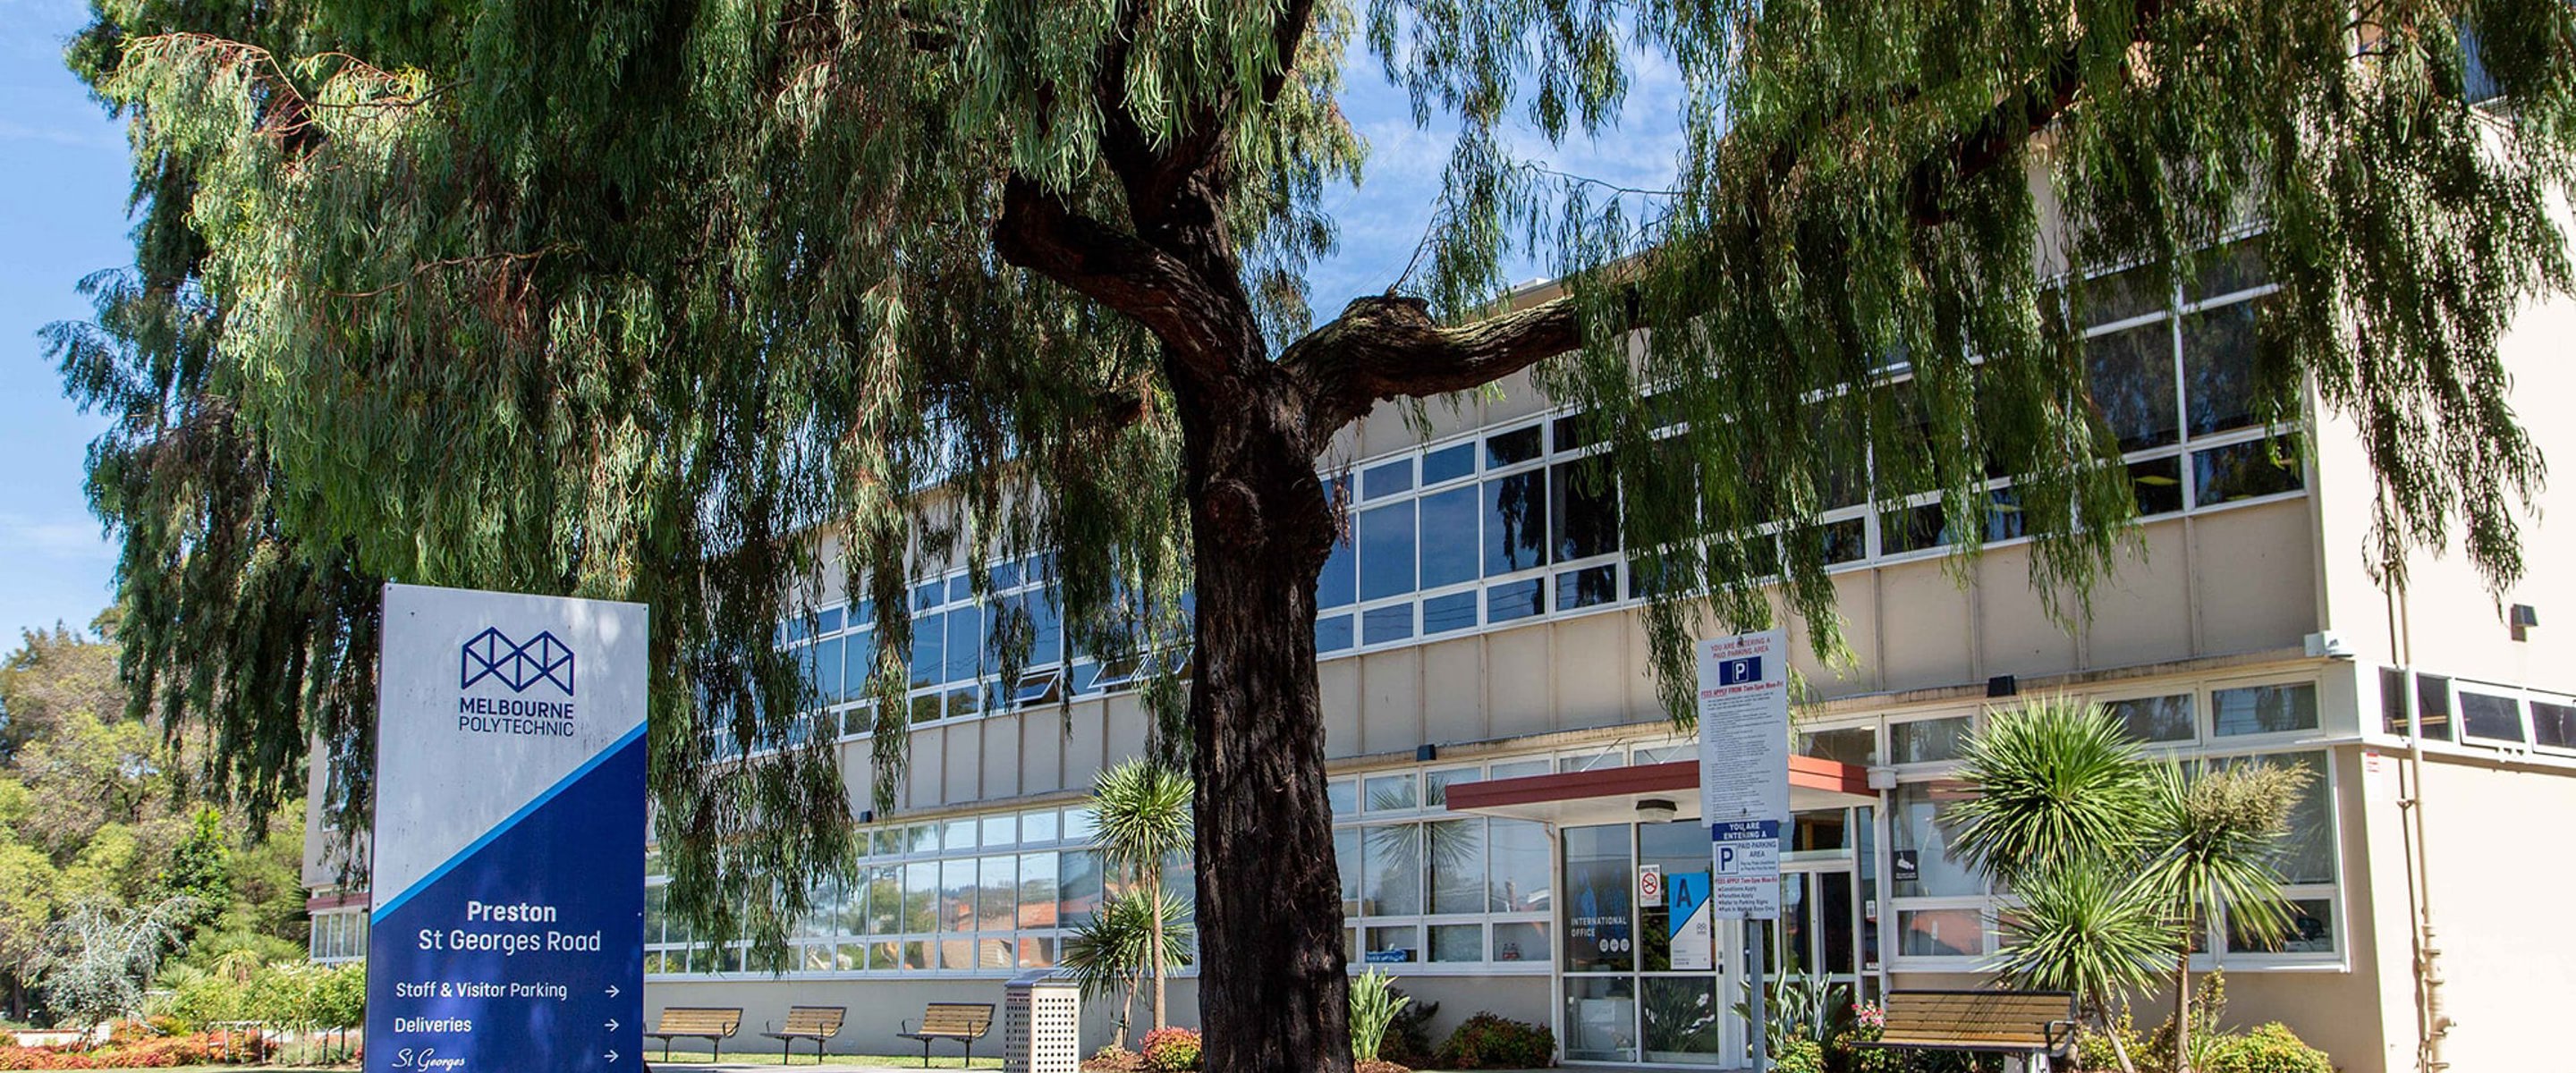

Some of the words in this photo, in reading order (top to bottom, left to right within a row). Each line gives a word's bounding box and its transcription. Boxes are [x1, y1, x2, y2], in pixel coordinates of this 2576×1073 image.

[1710, 644, 1723, 652] YOU
[1724, 641, 1735, 649] ARE
[1727, 647, 1752, 657] PARKING
[1754, 645, 1769, 654] AREA
[1735, 663, 1745, 680] P
[460, 697, 574, 720] MELBOURNE
[459, 715, 574, 737] POLYTECHNIC
[1729, 823, 1744, 831] YOU
[1746, 821, 1760, 830] ARE
[1761, 830, 1767, 838] A
[1750, 841, 1776, 849] PARKING
[1720, 848, 1733, 871] P
[1676, 878, 1692, 908] A
[467, 900, 557, 923] Preston
[1571, 916, 1628, 925] INTERNATIONAL
[1571, 927, 1596, 937] OFFICE
[418, 929, 444, 950] St
[450, 929, 541, 956] Georges
[547, 930, 601, 951] Road
[395, 981, 436, 998] Staff
[440, 983, 453, 998] &
[456, 982, 506, 998] Visitor
[510, 982, 568, 1001] Parking
[394, 1017, 472, 1033] Deliveries
[391, 1047, 413, 1068] St
[417, 1047, 466, 1073] Georges
